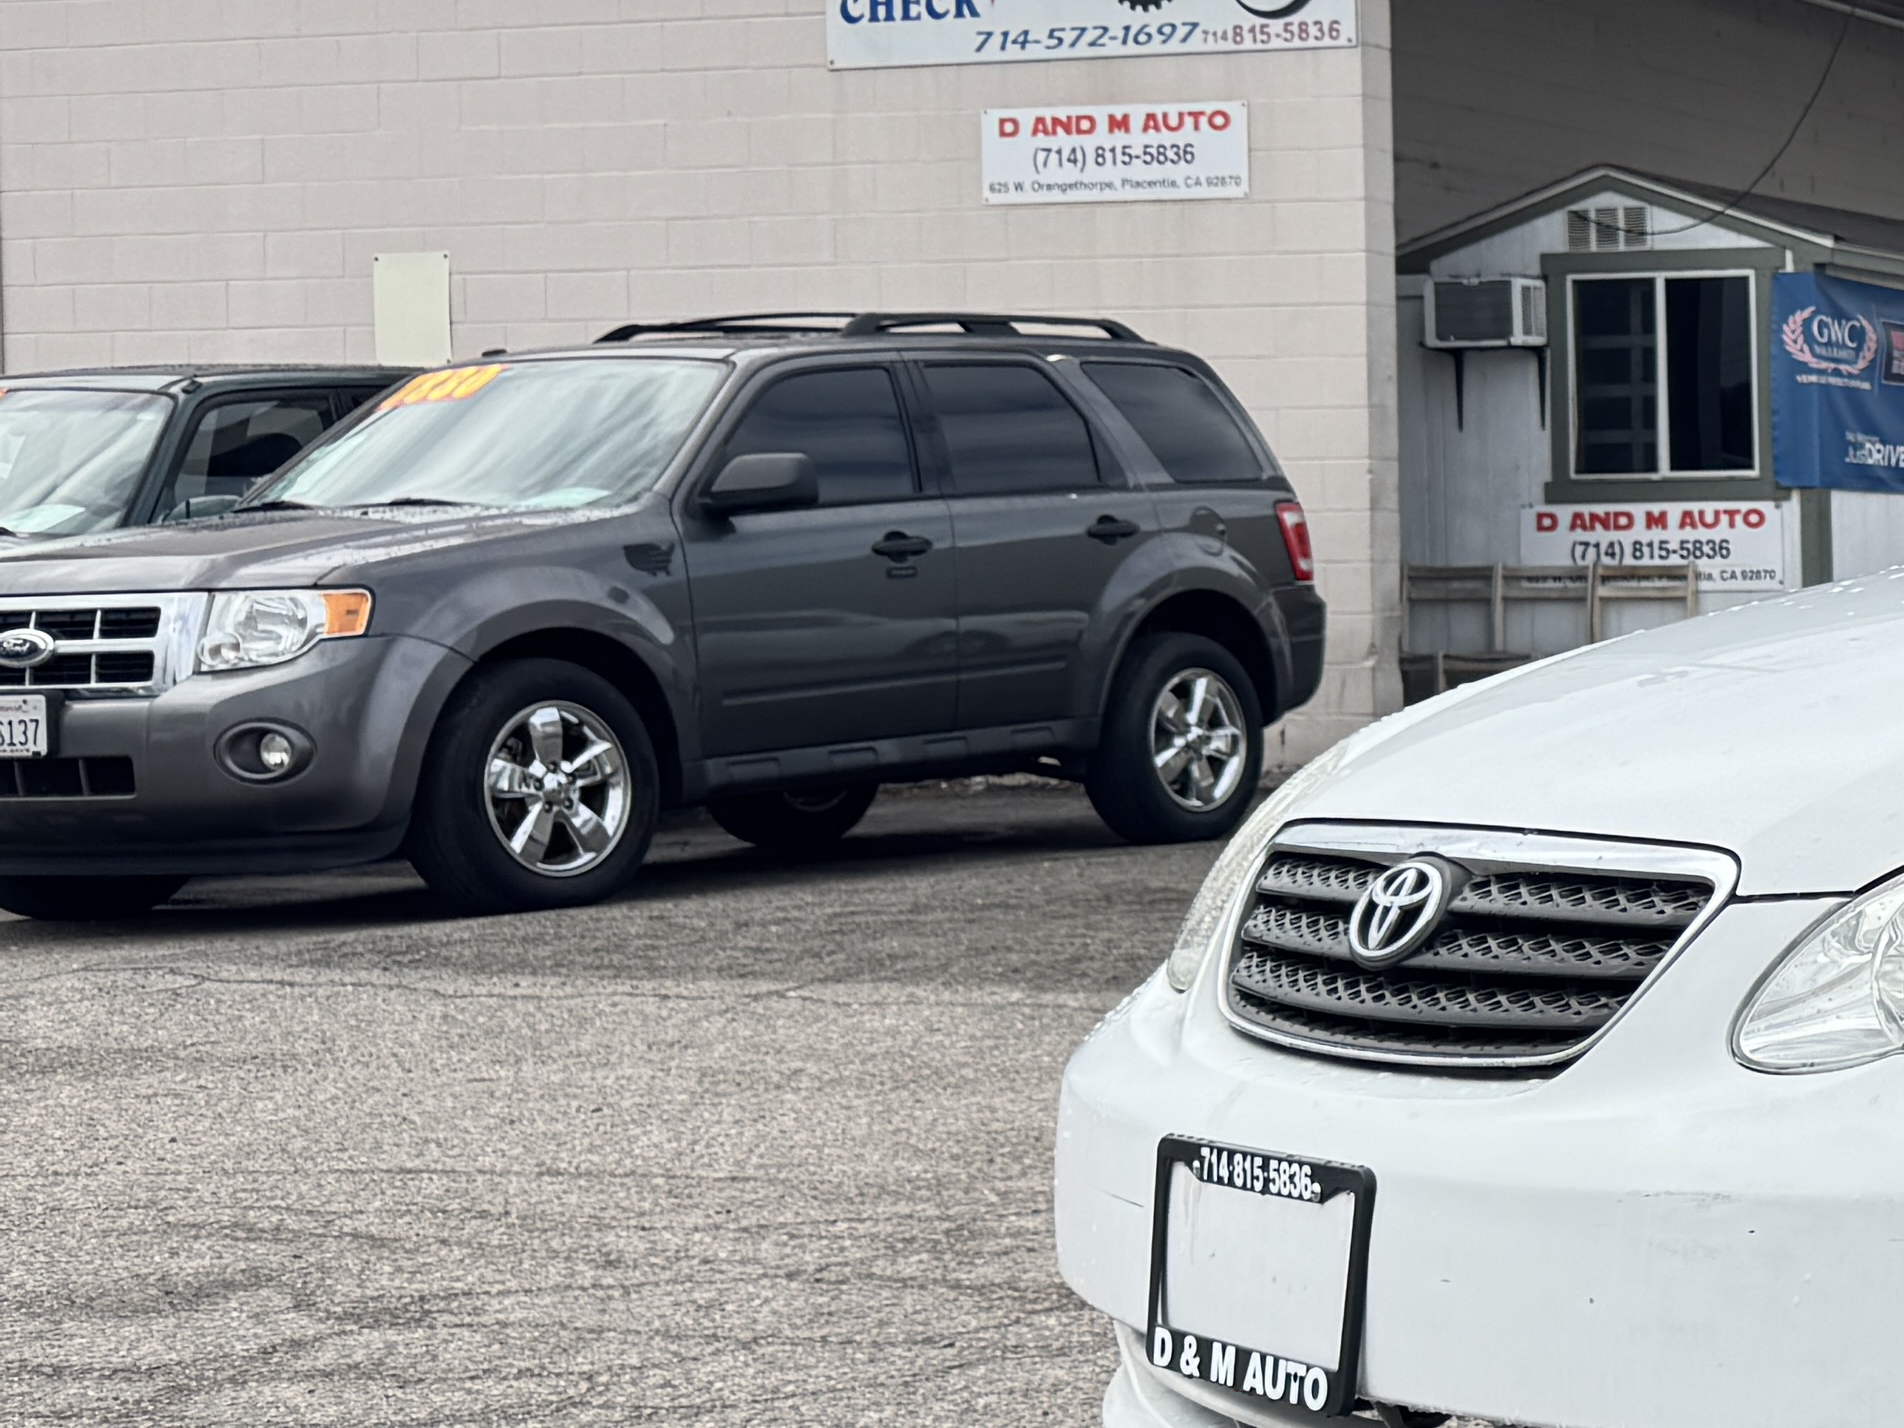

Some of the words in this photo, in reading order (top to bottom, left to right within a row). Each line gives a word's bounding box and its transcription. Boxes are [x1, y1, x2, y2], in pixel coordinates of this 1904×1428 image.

[974, 21, 1201, 53] 714-572-1697
[998, 116, 1020, 138] D
[1031, 114, 1097, 138] AND
[1107, 112, 1131, 135] M
[1142, 109, 1232, 134] AUTO
[1032, 146, 1087, 175] (714)
[1094, 143, 1196, 169] 815-5836
[1184, 175, 1203, 189] CA
[1812, 314, 1862, 349] GWC
[1536, 511, 1559, 533] D
[1569, 510, 1635, 532] AND
[1645, 509, 1669, 531] M
[1678, 508, 1767, 530] AUTO
[1570, 540, 1625, 566] (714)
[1632, 538, 1732, 561] 815-5836
[1720, 569, 1739, 582] CA
[1152, 1325, 1174, 1368] D
[1179, 1334, 1201, 1378] &
[1209, 1341, 1237, 1388] M
[1242, 1350, 1329, 1412] AUTO
